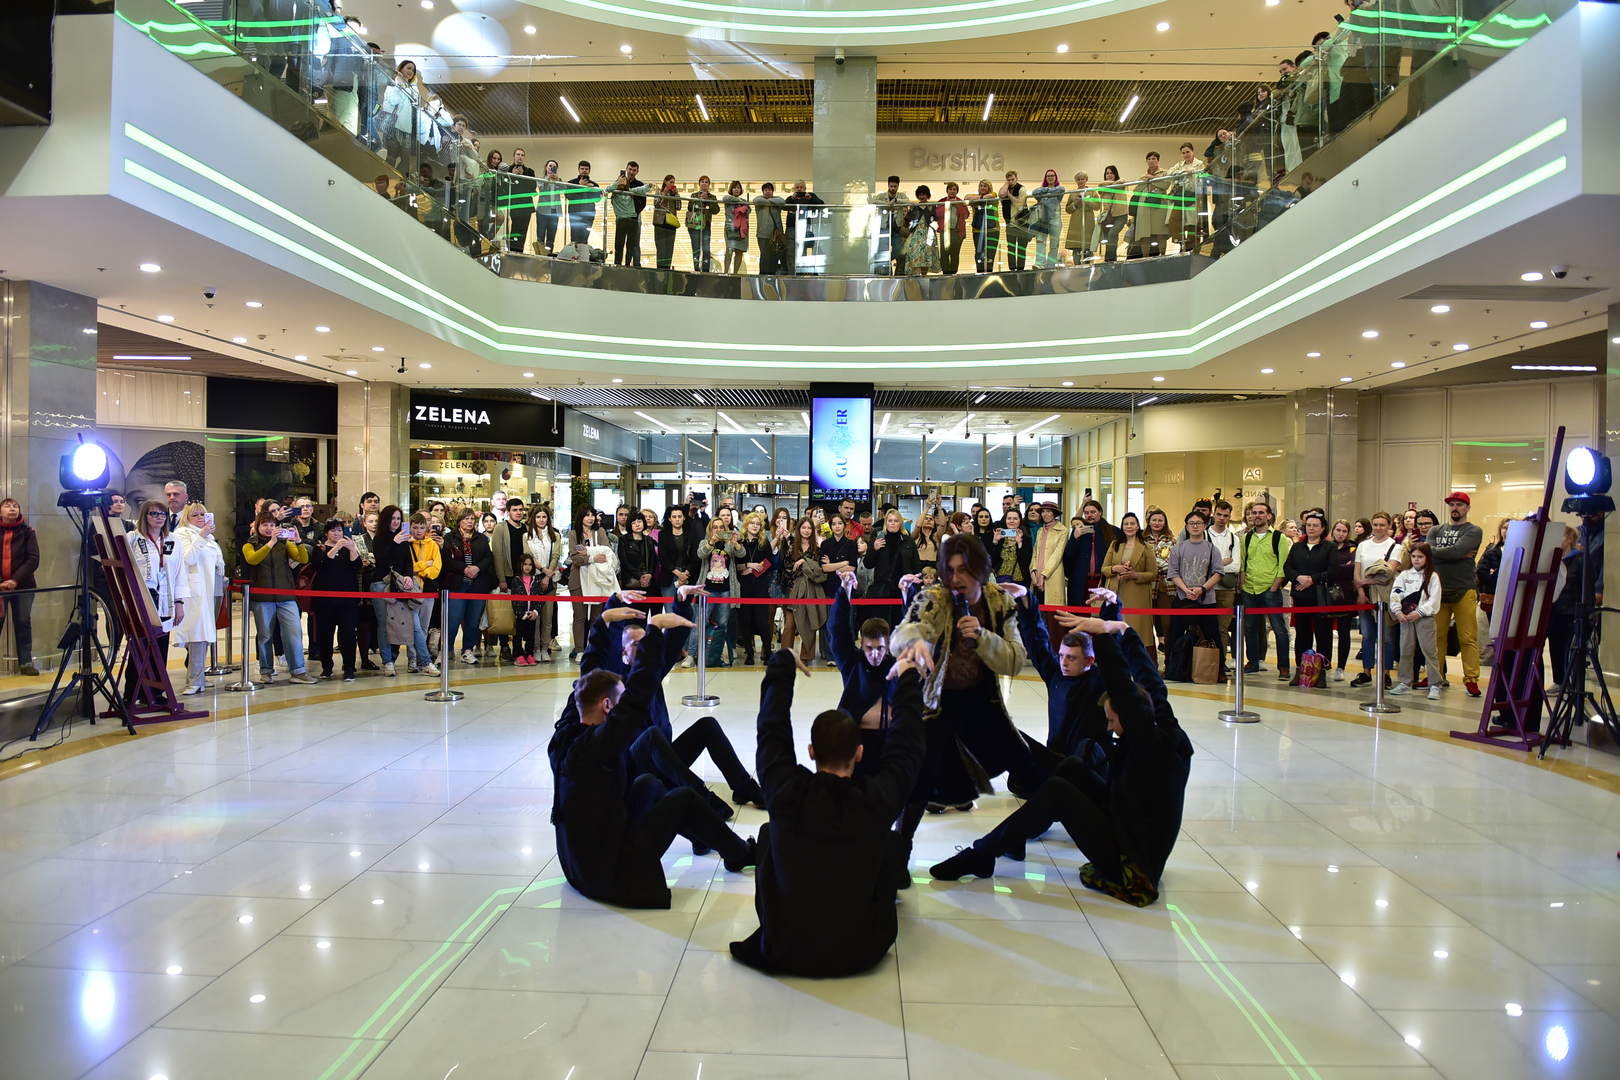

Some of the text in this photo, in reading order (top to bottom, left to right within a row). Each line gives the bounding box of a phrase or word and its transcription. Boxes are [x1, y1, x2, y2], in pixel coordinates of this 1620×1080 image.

[910, 147, 1004, 172] Bershka
[415, 405, 490, 425] ZELENA
[582, 424, 600, 441] ZELENA
